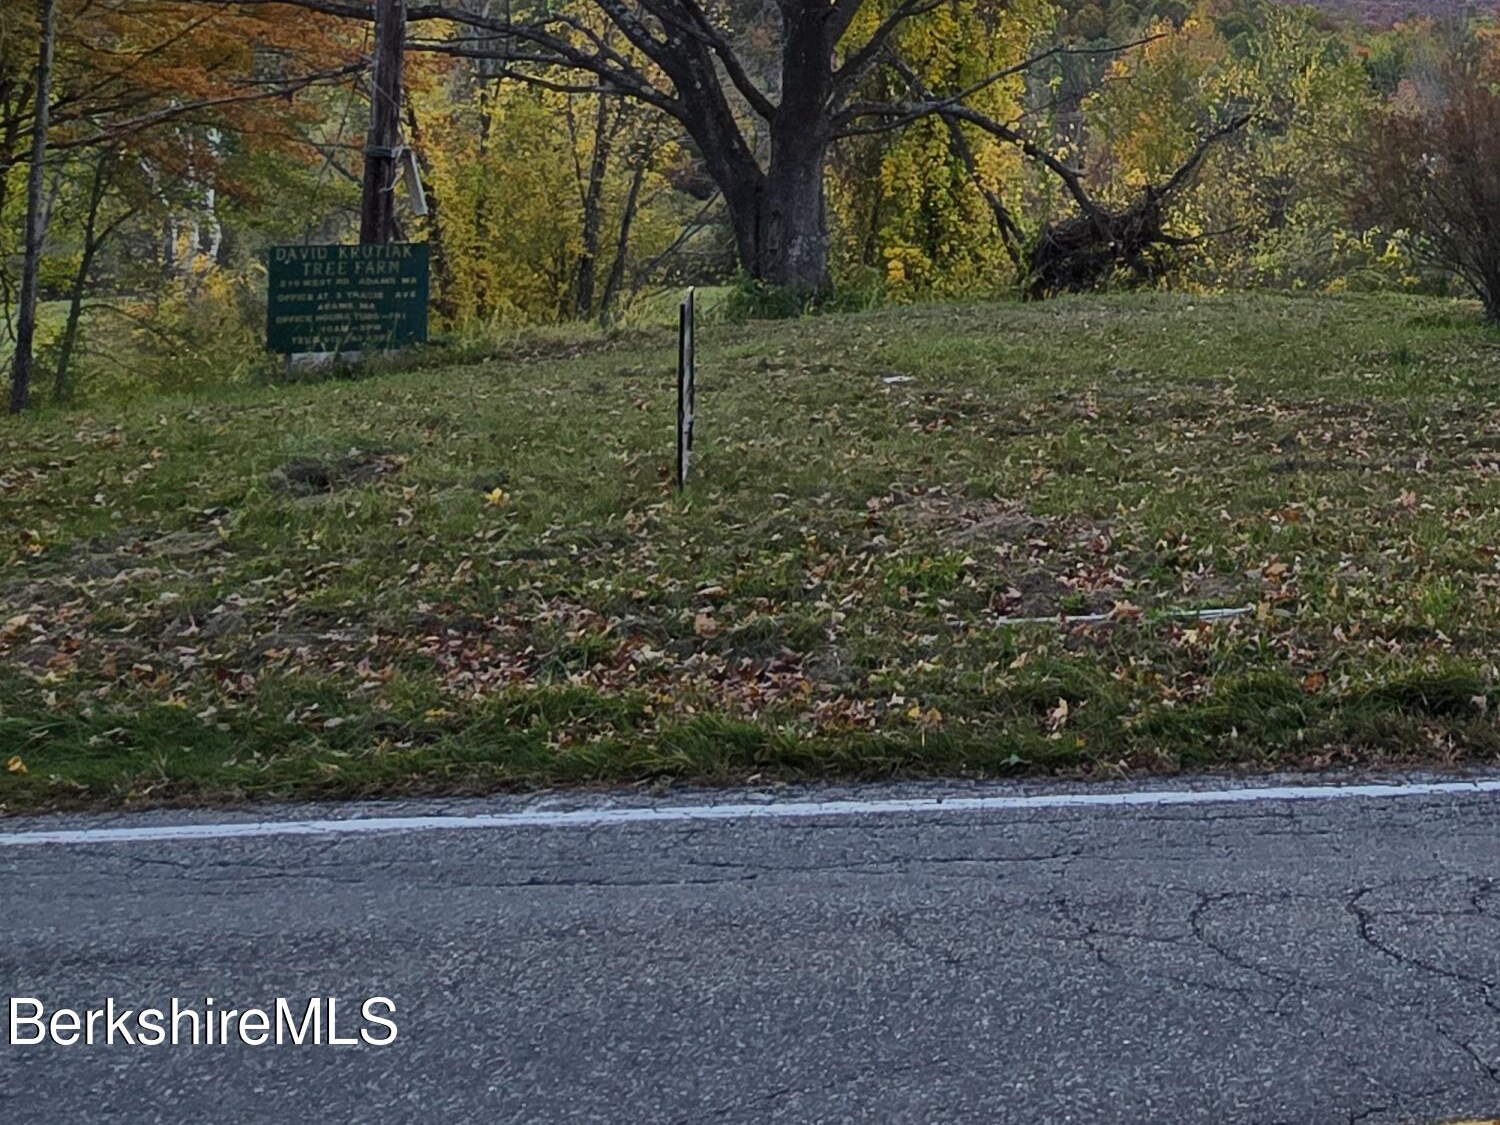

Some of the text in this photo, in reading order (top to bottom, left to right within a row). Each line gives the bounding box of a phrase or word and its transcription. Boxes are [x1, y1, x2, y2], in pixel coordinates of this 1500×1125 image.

[276, 245, 412, 261] DAVID KRUTIAK
[303, 260, 400, 276] TREE FARM
[276, 293, 314, 302] OFFICE
[317, 292, 328, 300] AT
[394, 290, 417, 299] AVE
[275, 315, 313, 324] OFFICE
